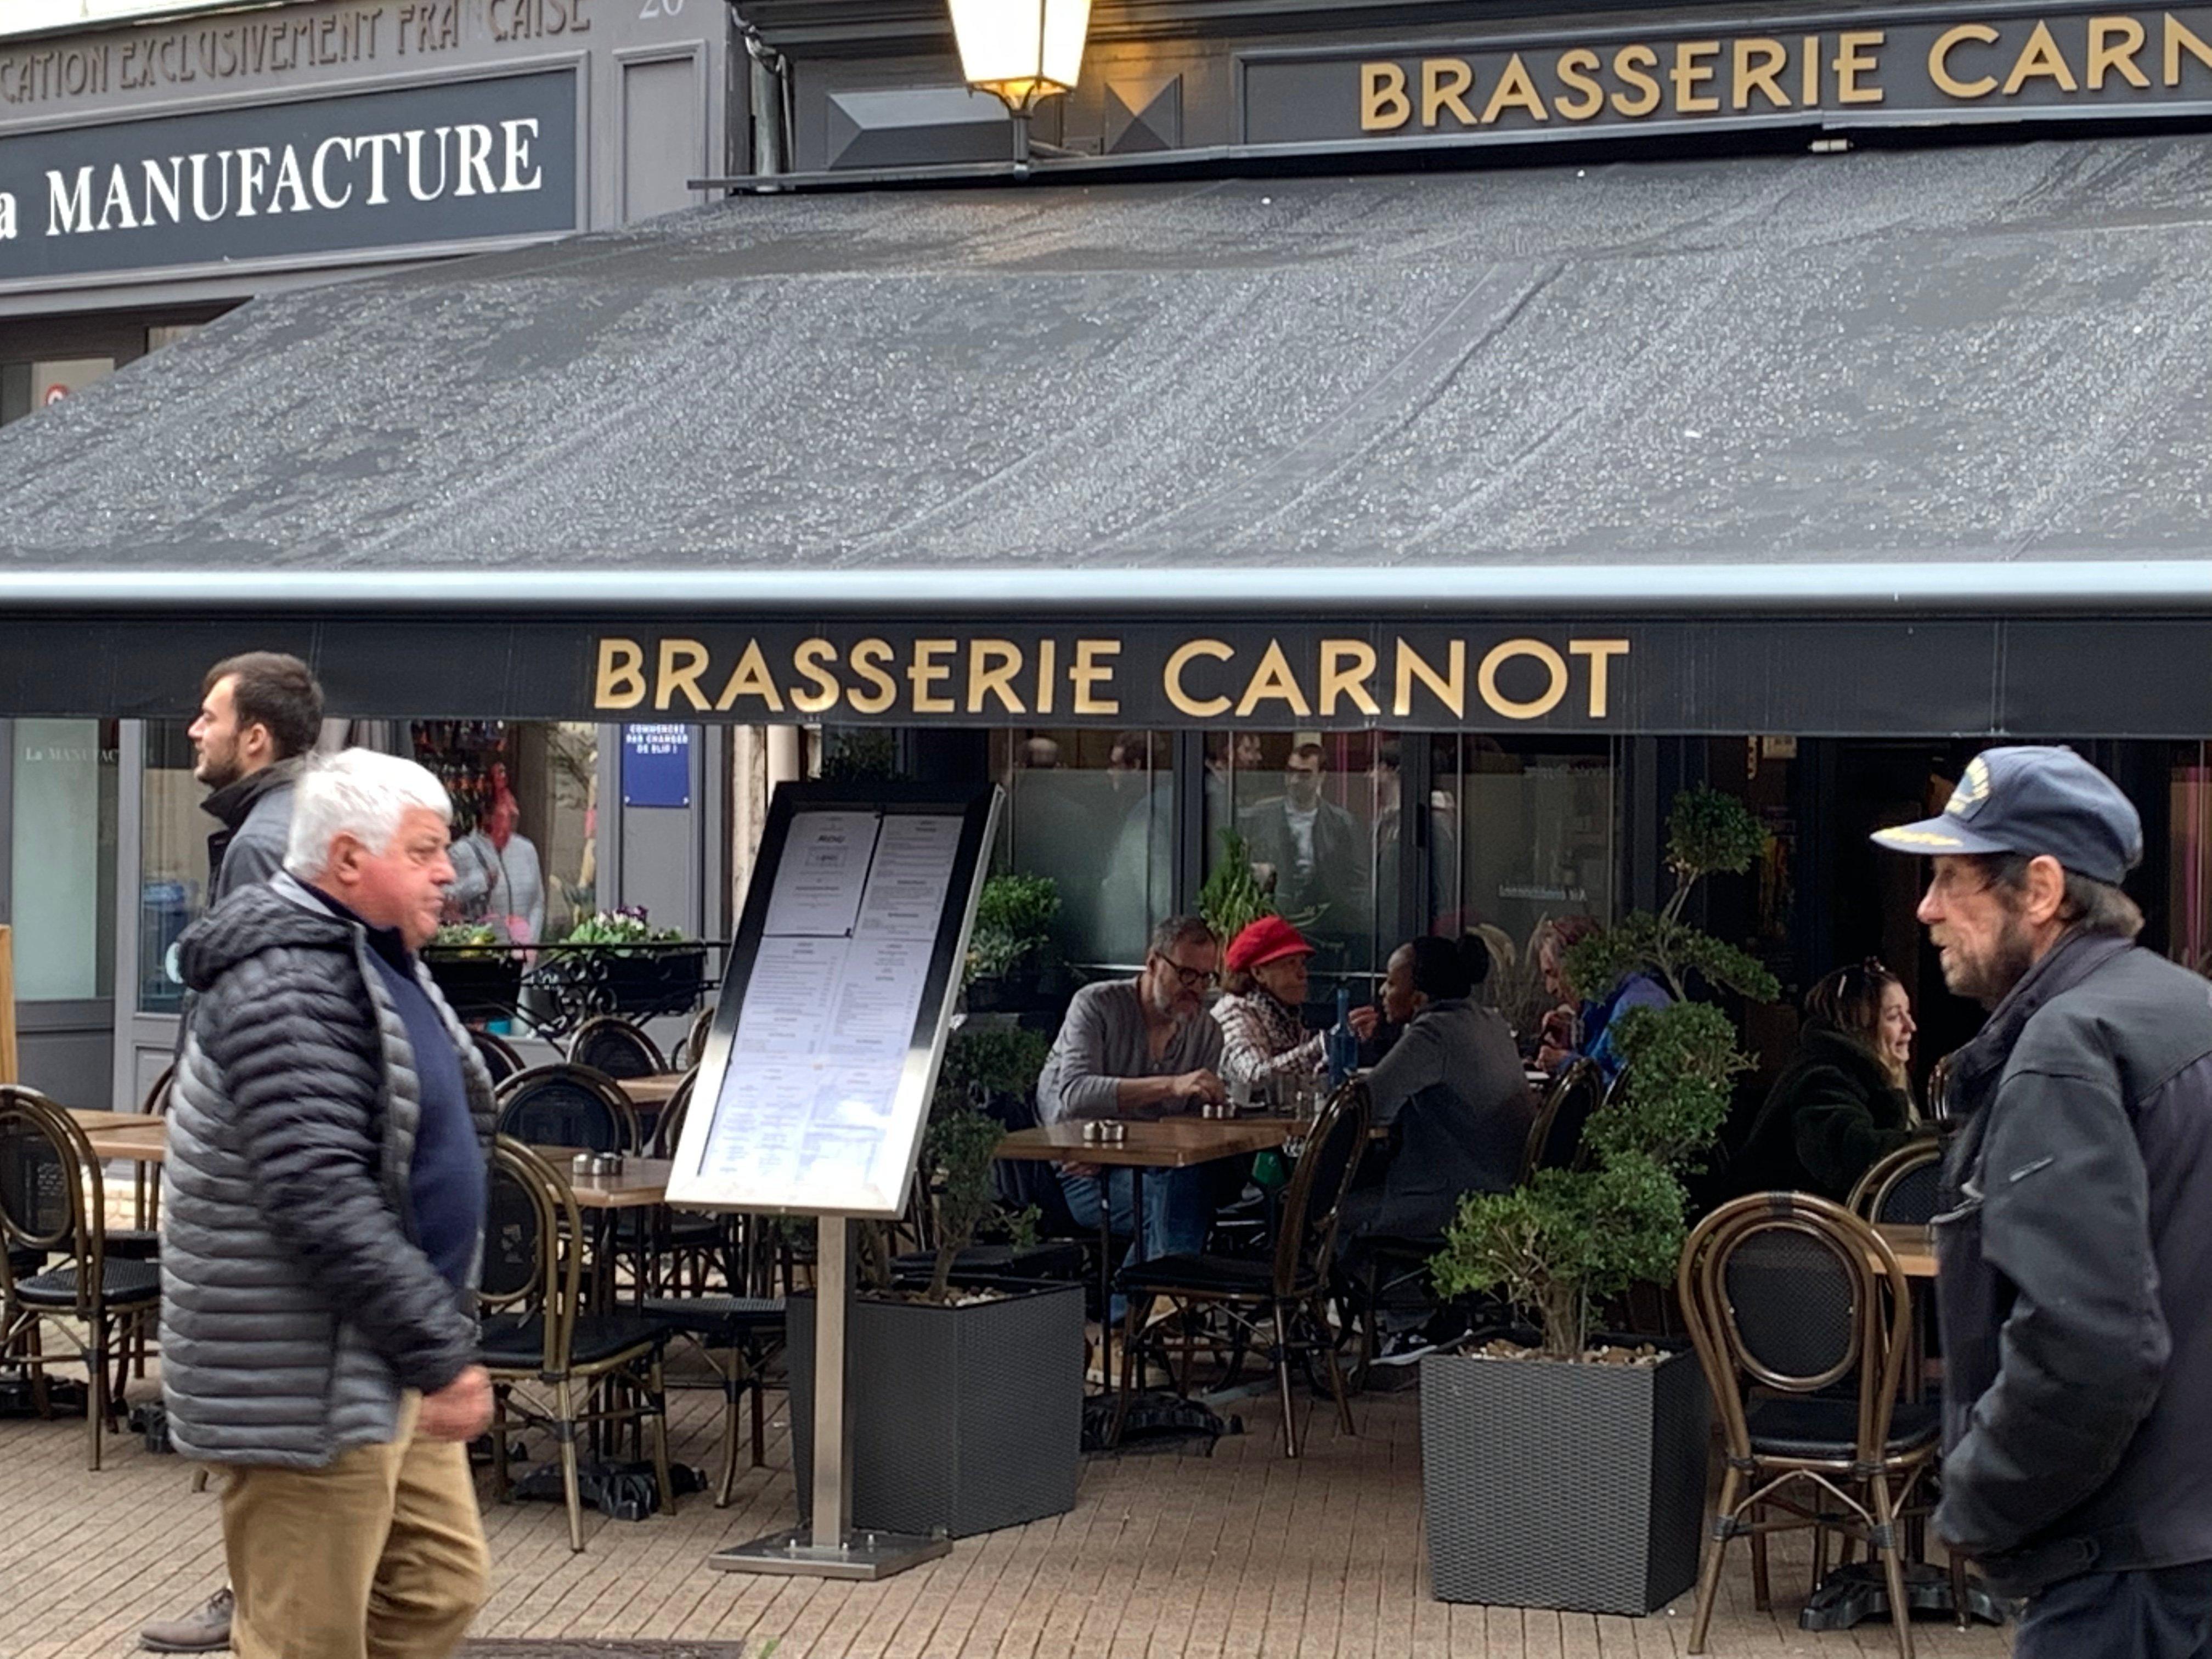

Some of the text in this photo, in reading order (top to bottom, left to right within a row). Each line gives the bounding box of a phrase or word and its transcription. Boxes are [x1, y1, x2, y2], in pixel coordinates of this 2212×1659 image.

[120, 8, 383, 89] EXCLUSIVEMENT
[1360, 31, 1886, 131] BRASSERIE
[45, 118, 543, 236] MANUFACTURE
[594, 636, 1631, 720] BRASSERIE CARNOT
